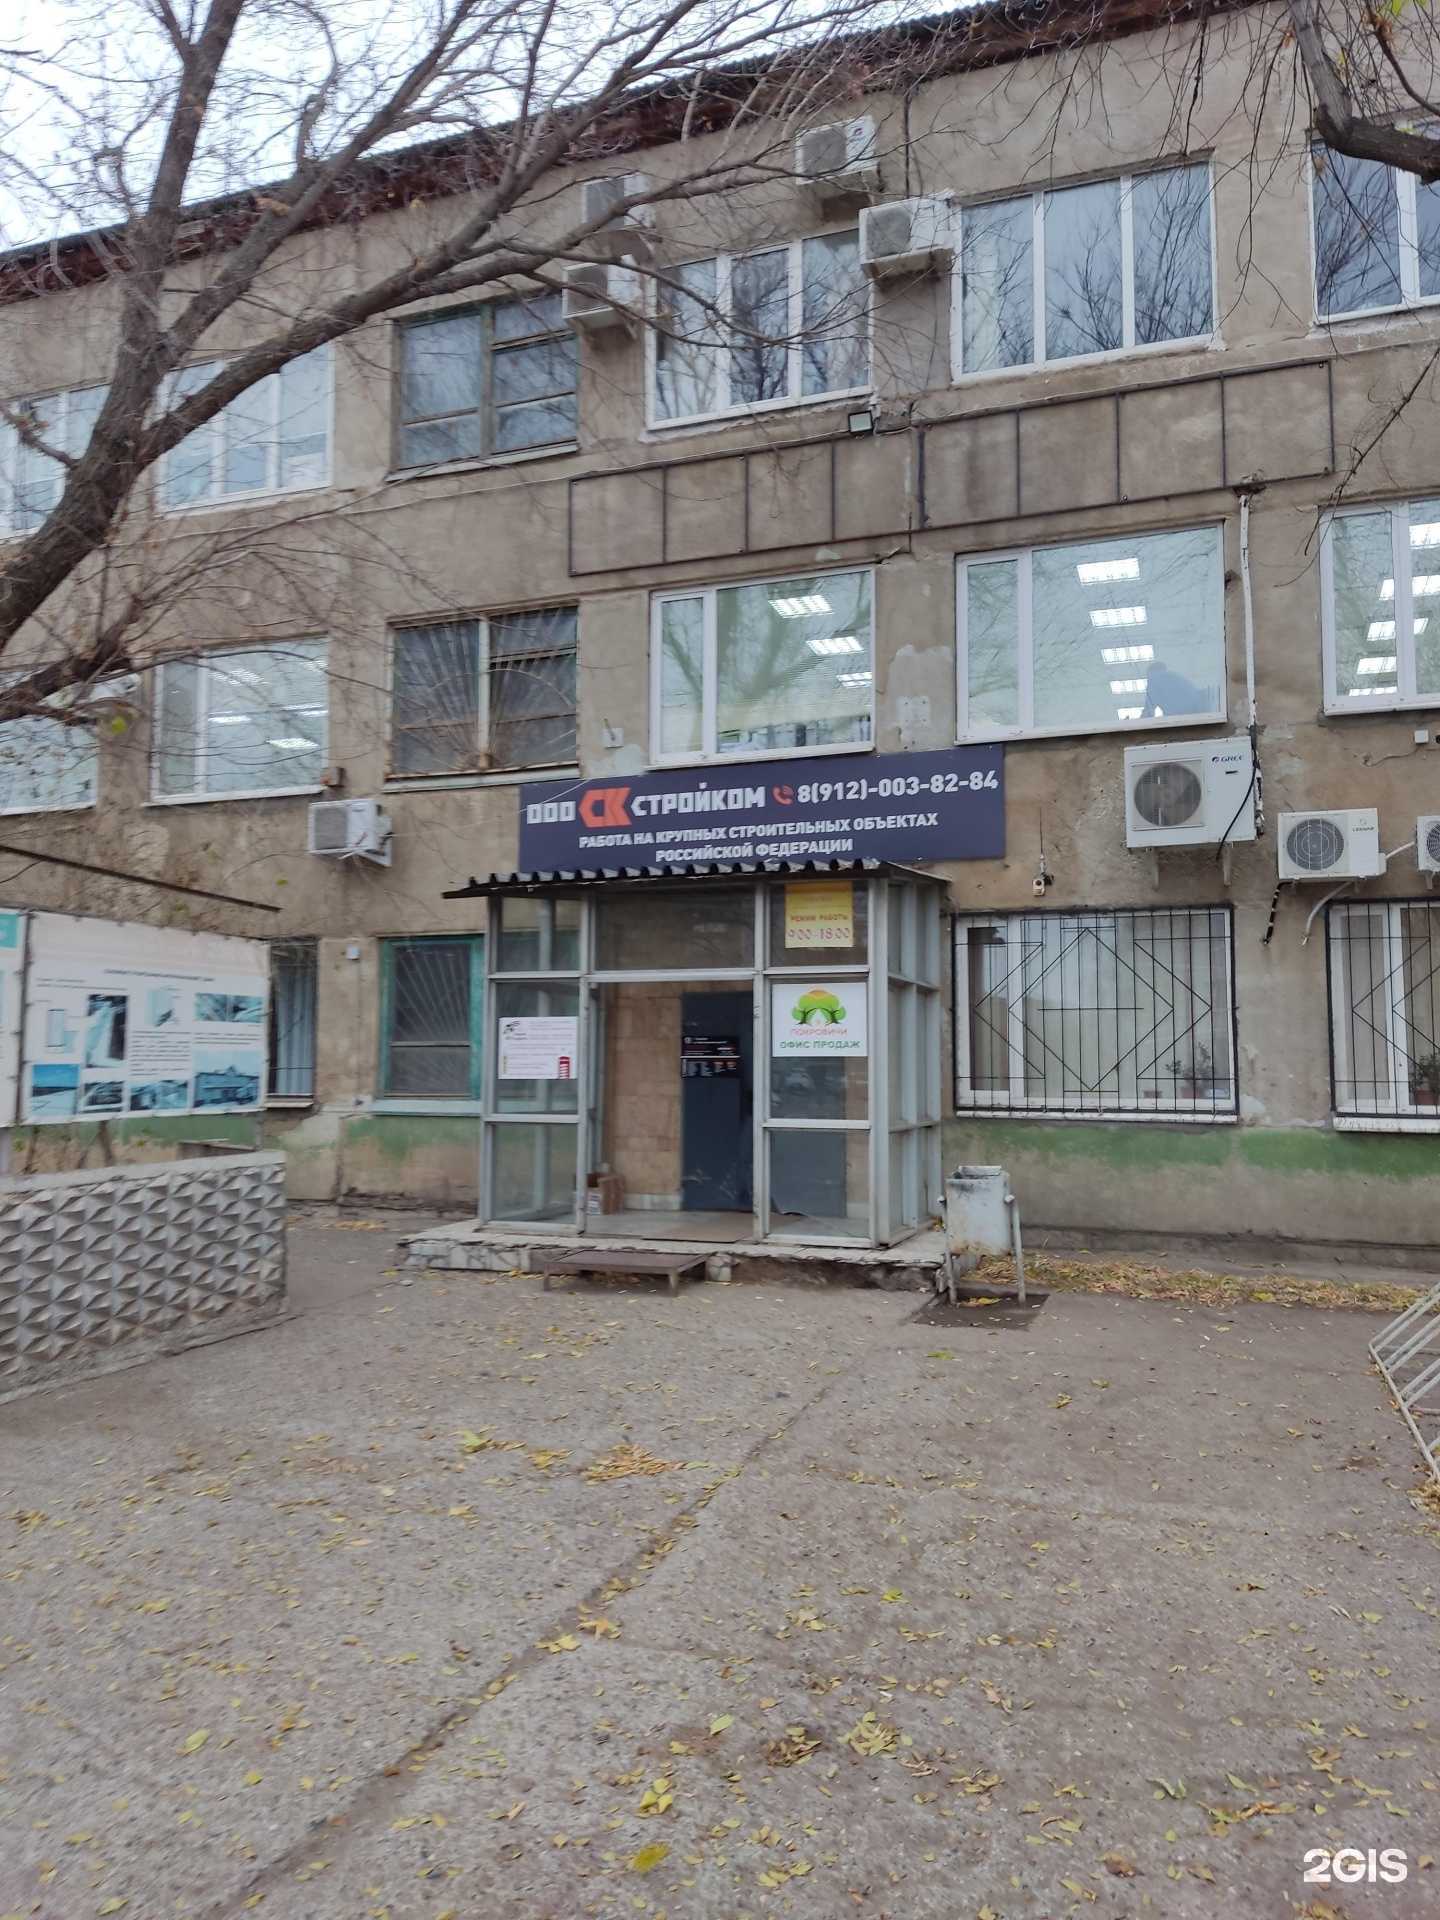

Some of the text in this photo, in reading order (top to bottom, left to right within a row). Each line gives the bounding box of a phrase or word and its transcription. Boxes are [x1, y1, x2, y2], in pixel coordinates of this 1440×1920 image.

[526, 769, 999, 828] ООО СК СТРОЙКОМ 8(912)-003-82-84
[579, 812, 939, 849] РАБОТА НА КРУПНЫХ СТРОИТЕЛЬНЫХ ОБЪЕКТАХ
[655, 838, 854, 862] РОССИЙСКОЙ ФЕДЕРАЦИИ
[819, 912, 849, 921] РАБОТЫ
[779, 1040, 861, 1051] ОФИС ПРОДАЖ
